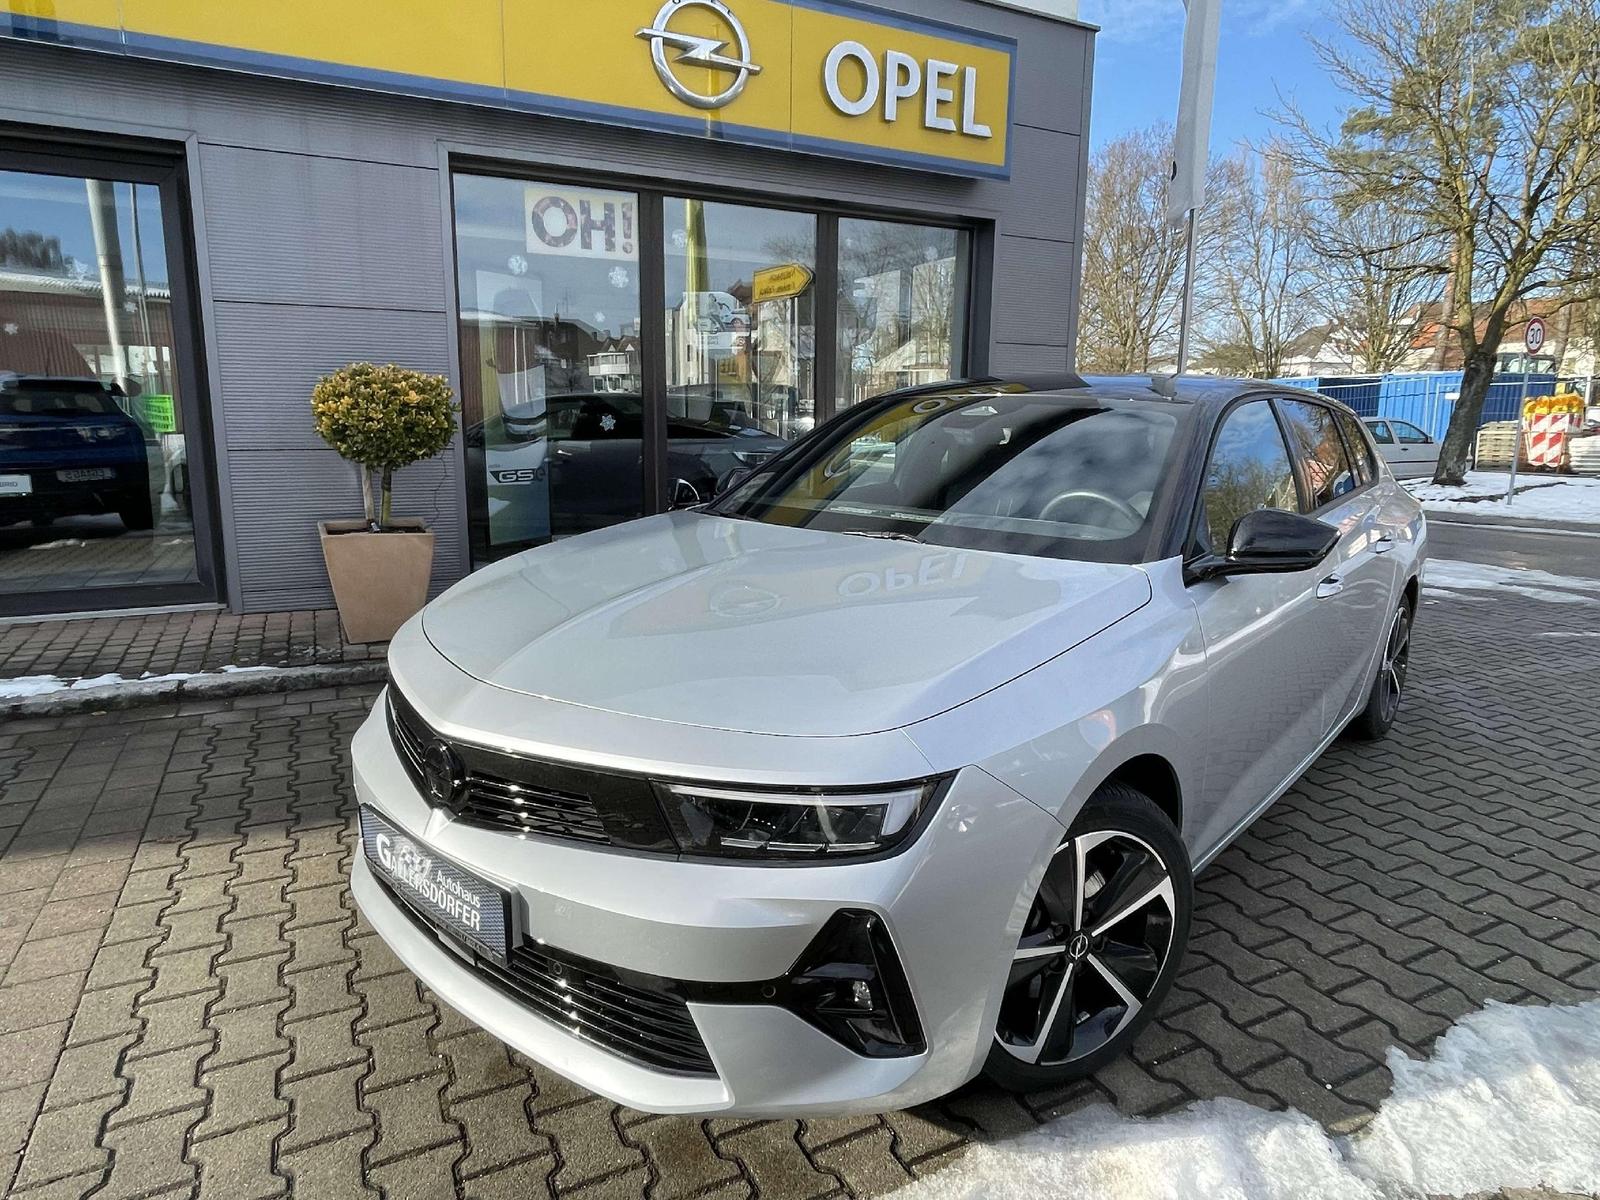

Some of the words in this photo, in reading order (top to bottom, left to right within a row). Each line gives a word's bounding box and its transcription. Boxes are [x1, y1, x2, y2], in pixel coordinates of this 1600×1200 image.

[825, 40, 992, 138] OPEL
[532, 196, 633, 254] OH!
[1529, 328, 1541, 345] 30
[436, 870, 480, 908] Autohaus
